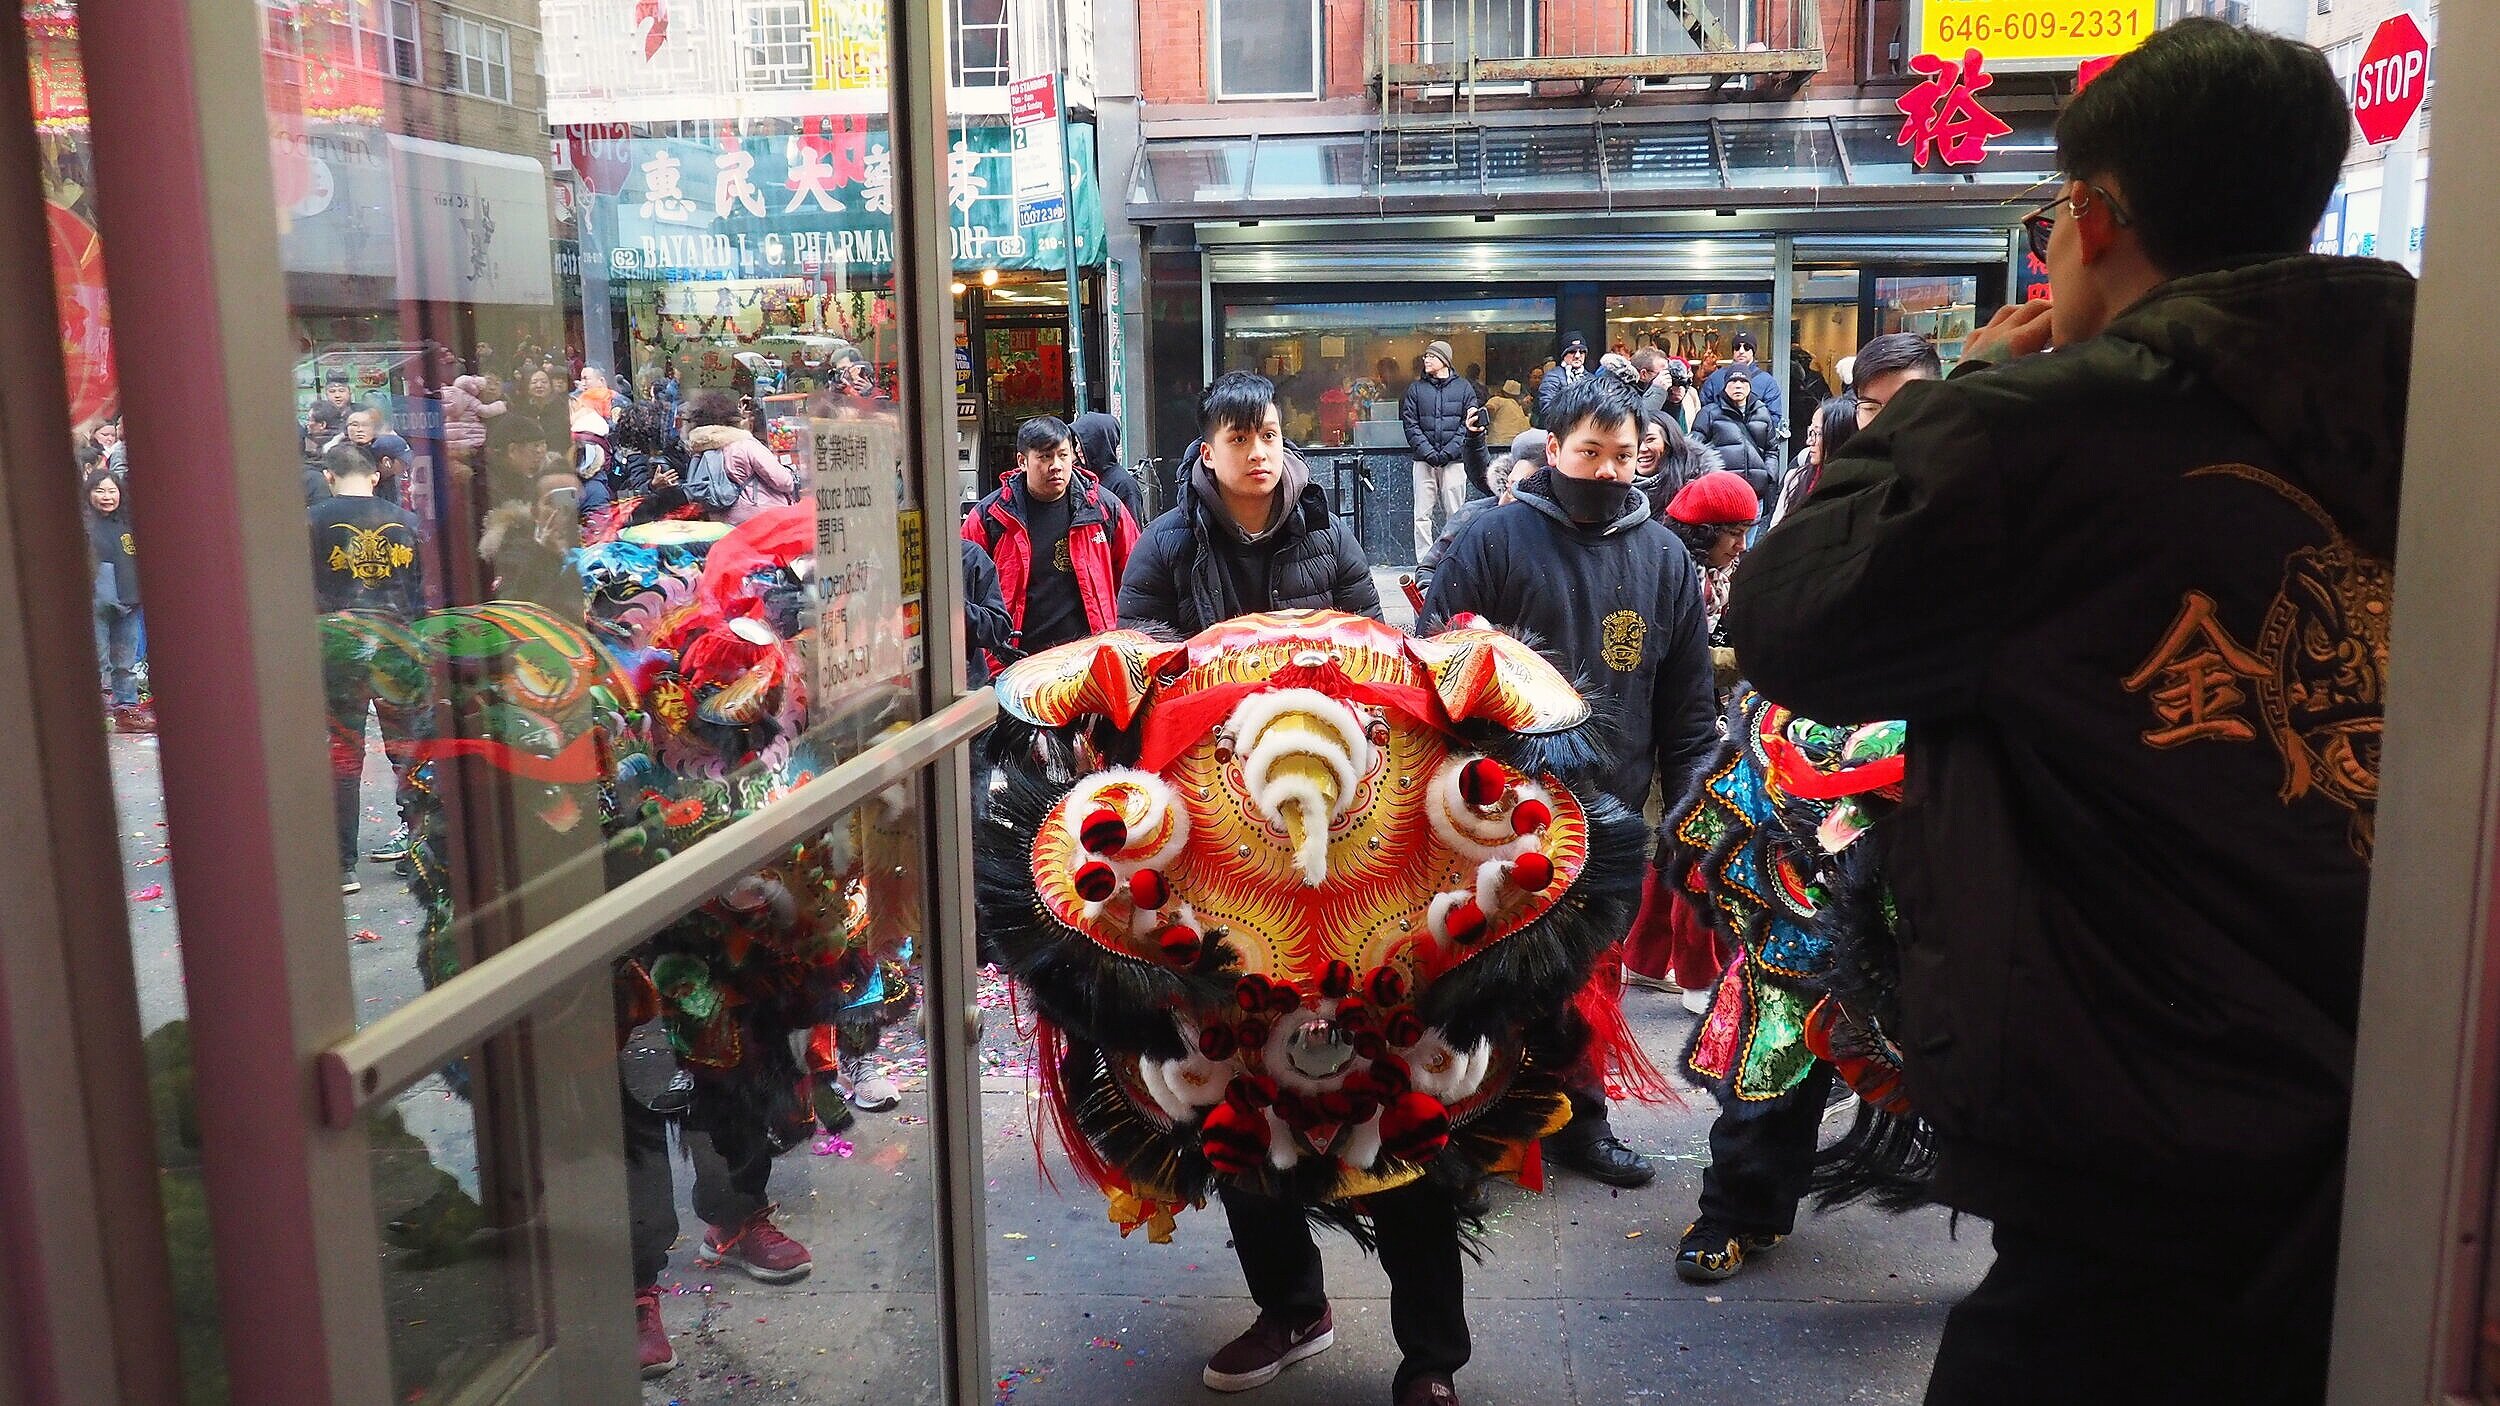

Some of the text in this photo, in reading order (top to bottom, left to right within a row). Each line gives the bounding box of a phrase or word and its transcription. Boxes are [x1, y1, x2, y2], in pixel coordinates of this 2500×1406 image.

[1939, 8, 2138, 43] 646-609-2331
[1010, 77, 1048, 95] NO STANDING
[2358, 49, 2424, 111] STOP
[1895, 47, 2014, 169] 裕
[1015, 128, 1026, 149] 2
[613, 249, 637, 267] 62
[640, 233, 731, 268] BAYARD
[791, 229, 894, 263] PHARMA
[951, 226, 992, 259] ORP.
[816, 432, 867, 472] 營業時間
[816, 477, 872, 511] store hours
[818, 517, 846, 555] 開門
[1601, 611, 1618, 627] NEW
[1617, 609, 1638, 619] YORK
[1601, 649, 1626, 672] GOLDEN
[2120, 590, 2276, 749] 金
